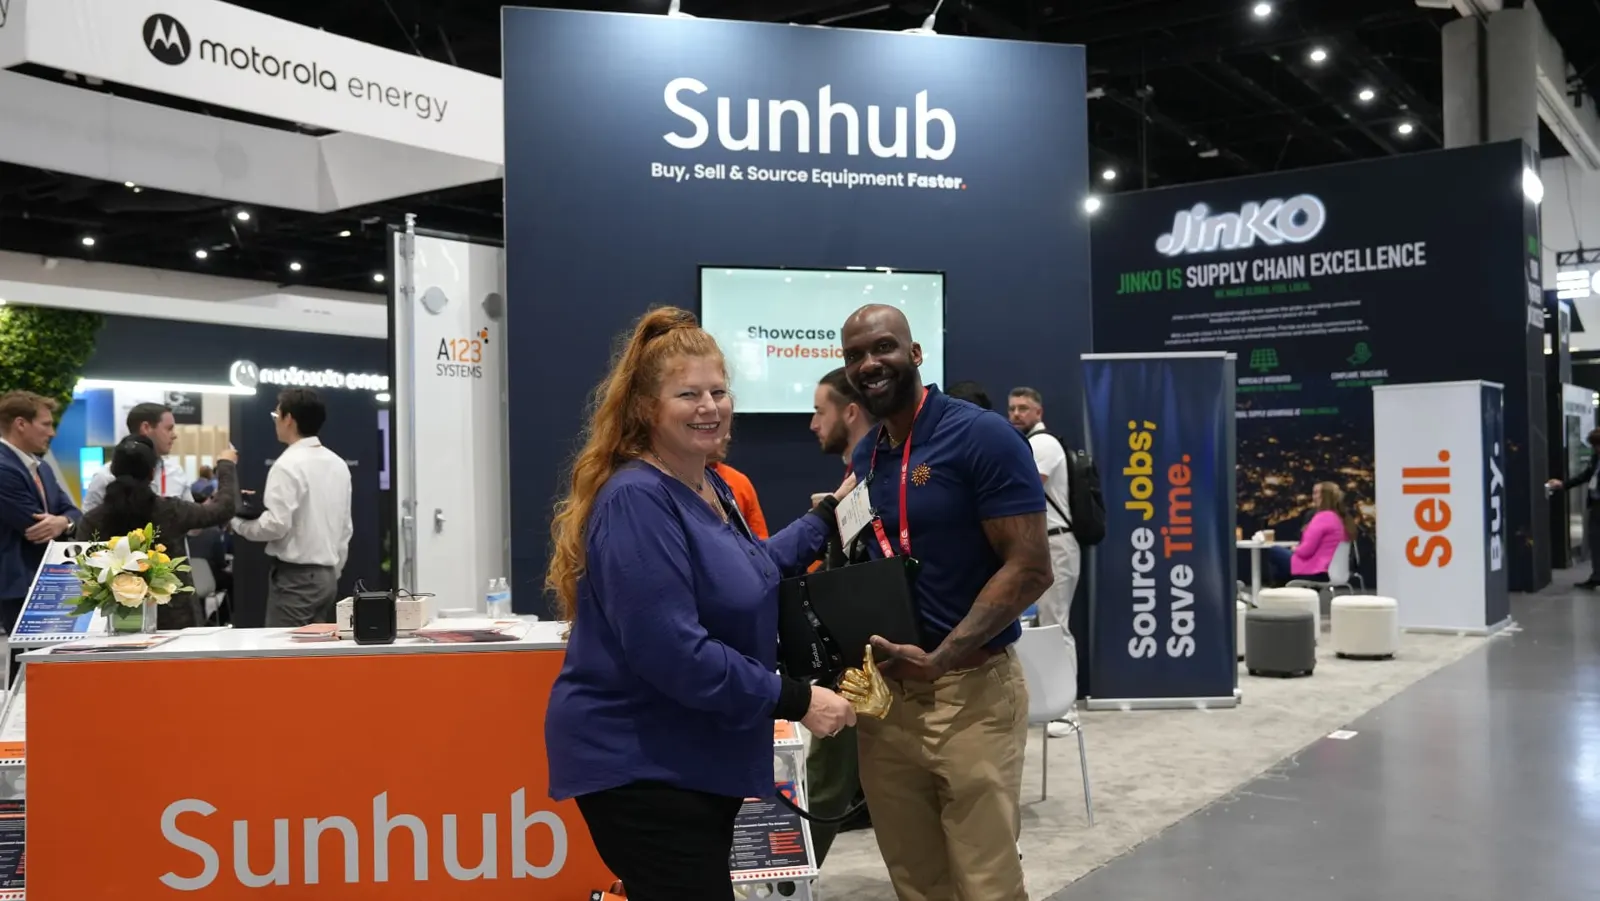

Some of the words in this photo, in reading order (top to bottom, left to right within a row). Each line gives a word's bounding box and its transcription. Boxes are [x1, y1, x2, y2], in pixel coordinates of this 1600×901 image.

[200, 39, 337, 92] motorola
[349, 77, 448, 122] energy
[663, 77, 957, 161] Sunhub
[651, 162, 690, 182] Buy,
[694, 163, 726, 179] Sell
[729, 165, 743, 180] &
[747, 166, 808, 183] Source
[812, 168, 904, 189] Equipment
[907, 172, 967, 190] Faster.
[1117, 270, 1162, 294] JINKO
[1166, 268, 1182, 290] IS
[1186, 261, 1248, 289] SUPPLY
[1252, 255, 1305, 281] CHAIN
[1310, 242, 1427, 277] EXCELLENCE
[436, 337, 482, 363] A123
[436, 364, 482, 379] SYSTEMS
[748, 325, 836, 340] Showcase
[259, 365, 345, 388] motorola
[1123, 419, 1157, 520] Jobs;
[1161, 454, 1193, 558] Time.
[1402, 449, 1453, 568] Sell.
[1128, 527, 1157, 658] Source
[1166, 564, 1195, 657] Save
[158, 787, 568, 891] Sunhub
